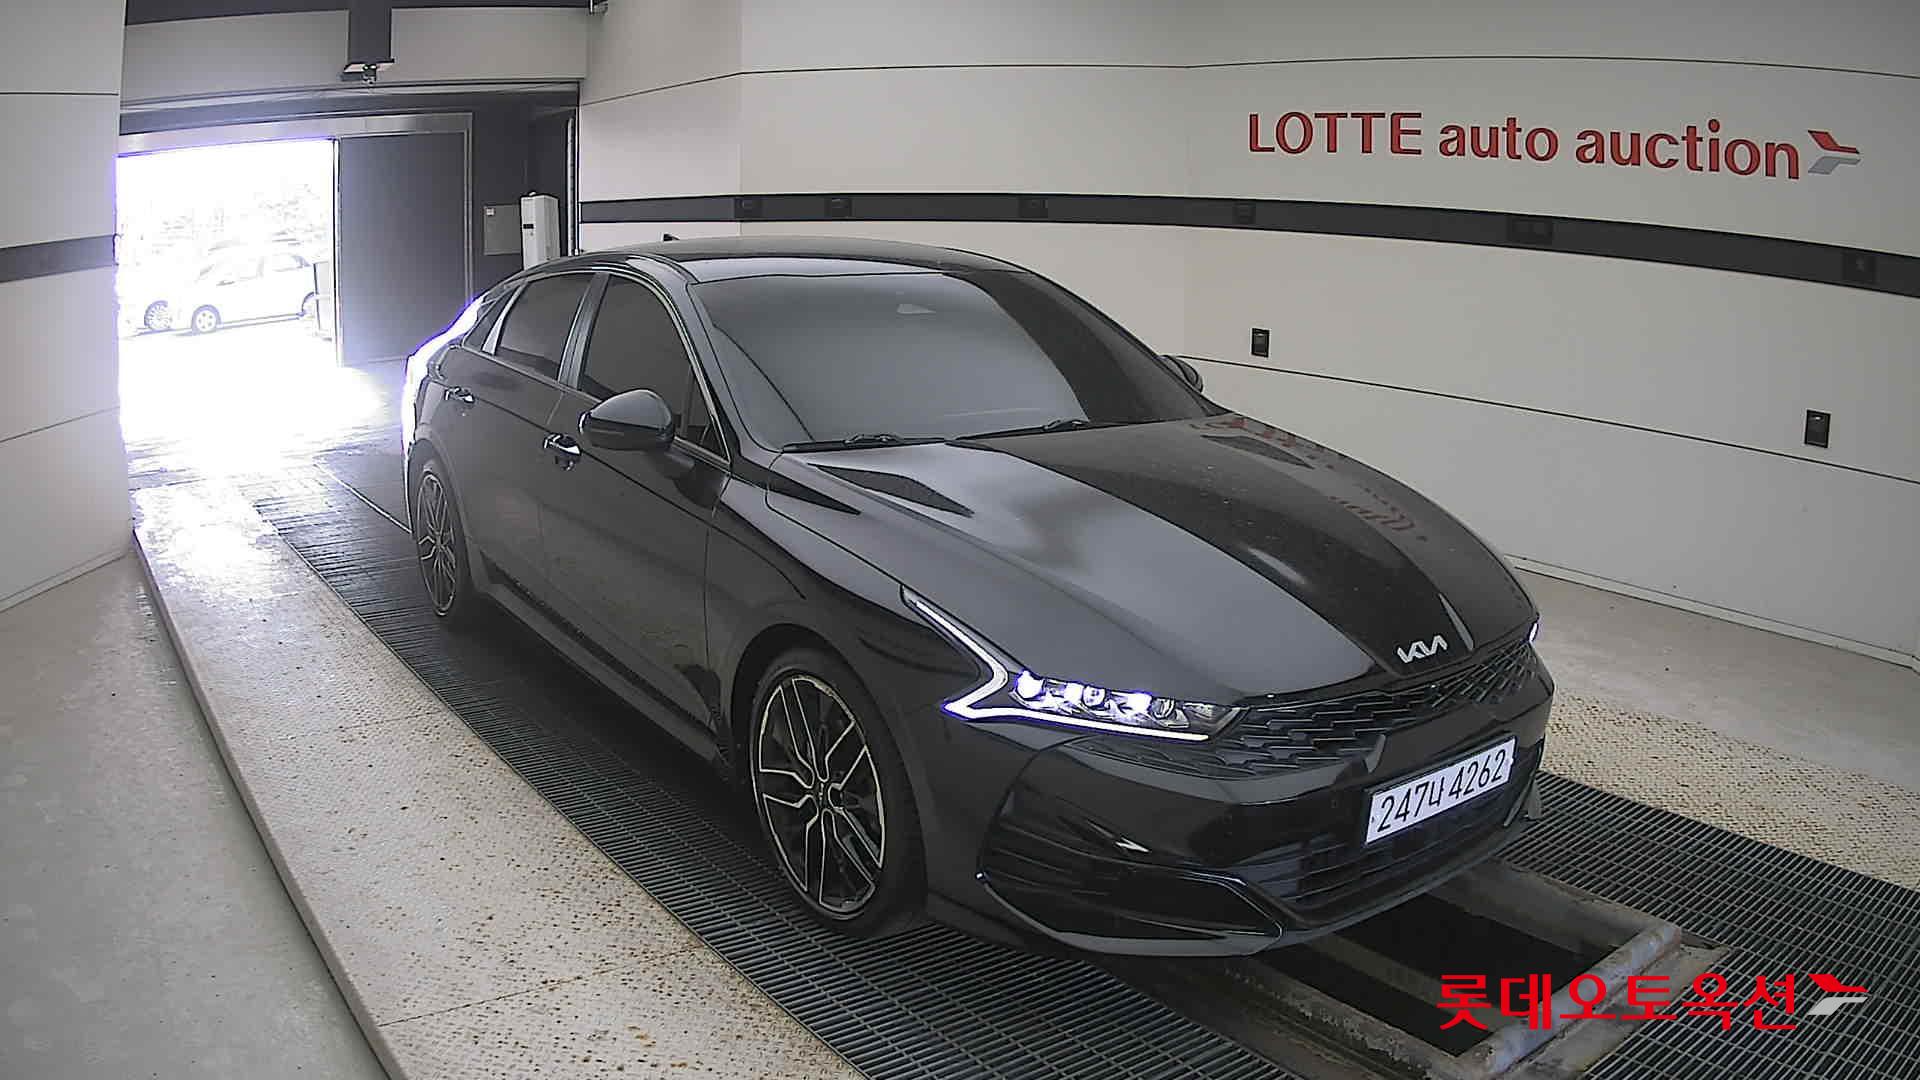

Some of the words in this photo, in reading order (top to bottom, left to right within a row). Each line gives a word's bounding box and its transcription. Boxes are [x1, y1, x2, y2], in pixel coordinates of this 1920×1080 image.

[1247, 111, 1423, 156] LOTTE
[1438, 116, 1559, 161] auto
[1574, 119, 1801, 180] auction
[1397, 635, 1448, 664] KIA
[1448, 748, 1508, 800] 4262
